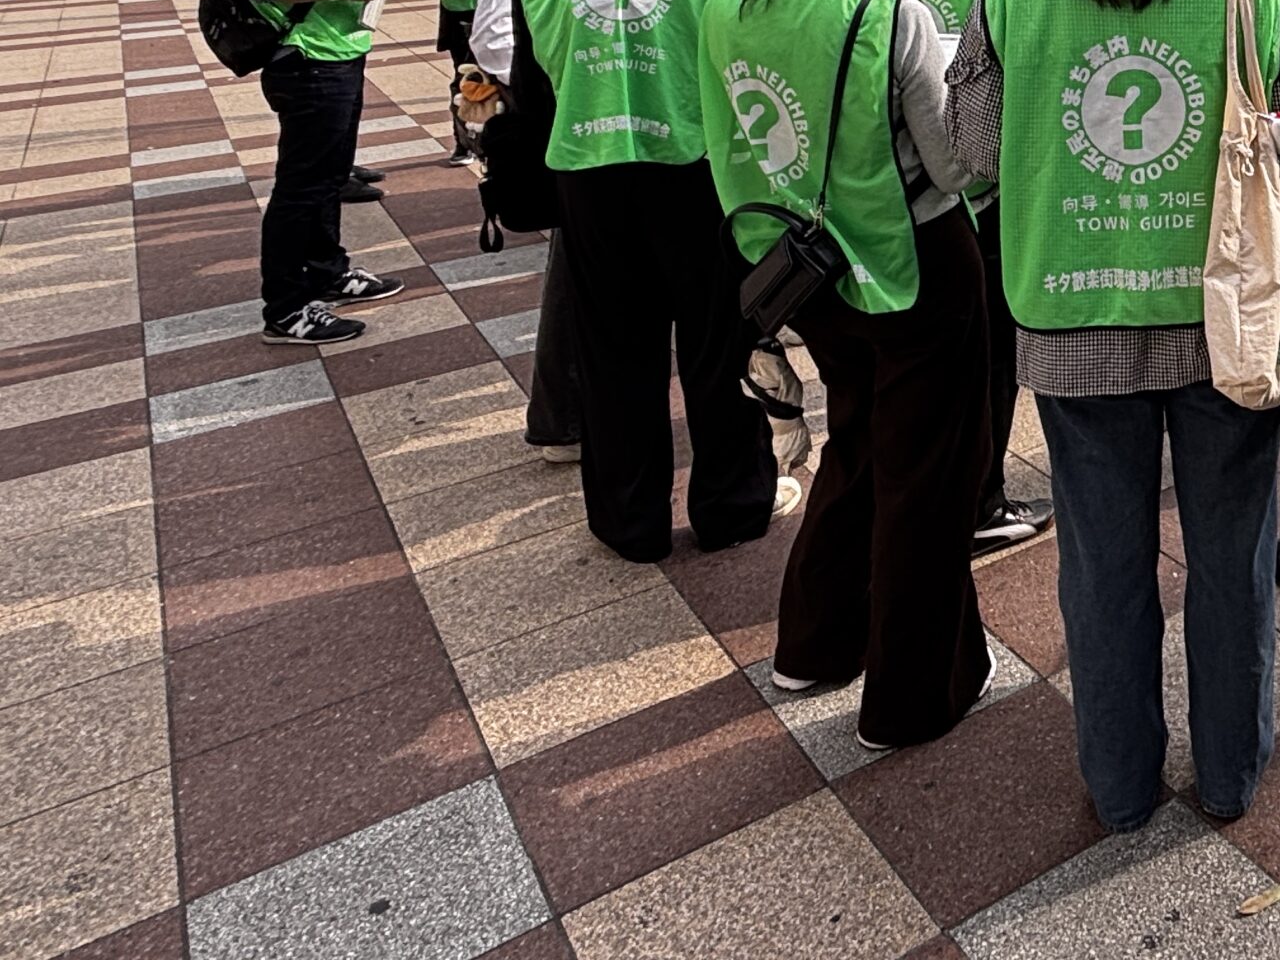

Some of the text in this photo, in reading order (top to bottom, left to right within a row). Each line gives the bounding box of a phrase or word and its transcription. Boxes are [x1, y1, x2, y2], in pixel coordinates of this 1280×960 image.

[1060, 34, 1130, 184] 地元民のまち案内
[1130, 35, 1206, 185] NEIGHBORHOOD
[1076, 214, 1196, 232] TOWN GUIDE
[1159, 191, 1207, 209] 가이드
